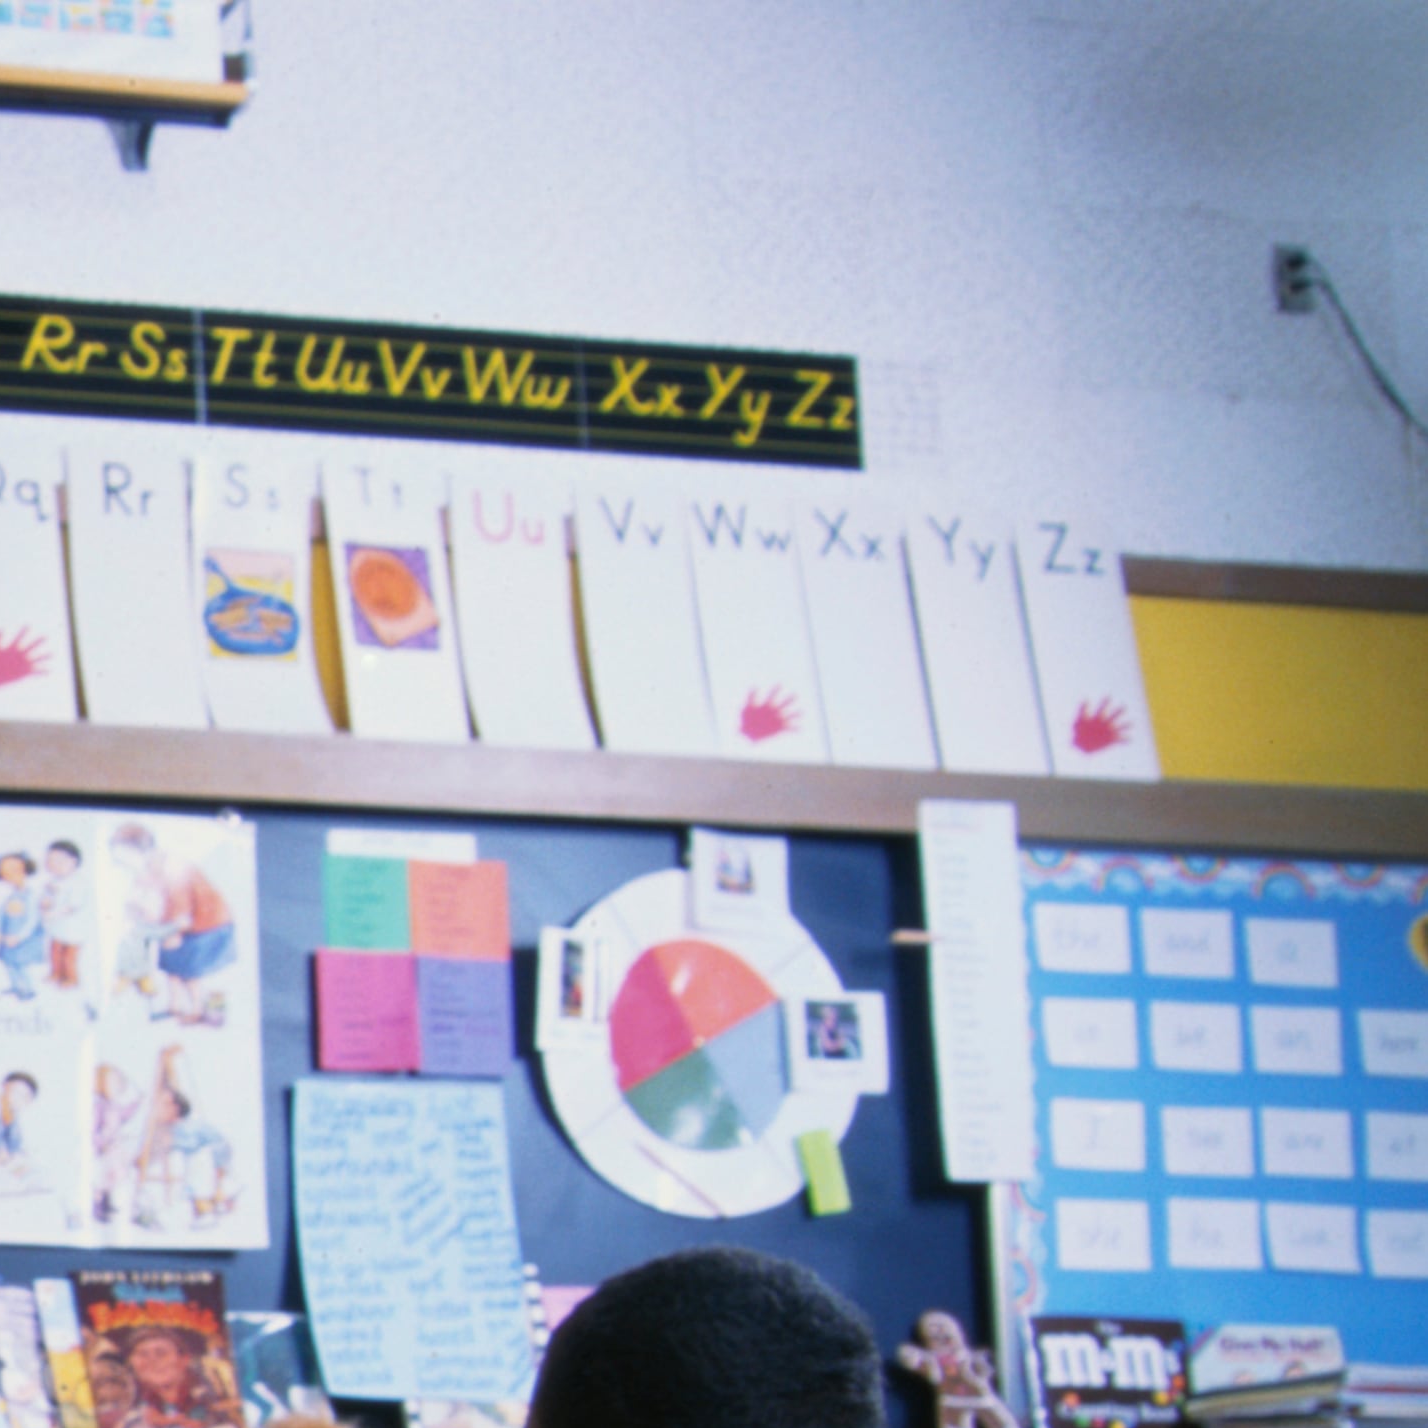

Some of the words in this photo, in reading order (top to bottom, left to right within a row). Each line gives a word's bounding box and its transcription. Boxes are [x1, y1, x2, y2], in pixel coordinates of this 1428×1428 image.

[20, 314, 108, 374] Rr
[120, 321, 188, 381] Ss
[211, 326, 277, 388] Tt
[295, 334, 372, 397] Uu
[379, 340, 452, 400] Vv
[463, 347, 571, 409] Ww
[600, 357, 684, 417] Xx
[701, 365, 772, 446] Yy
[787, 370, 854, 429] Zz
[104, 461, 155, 518] Rr
[470, 491, 546, 547] Uu
[598, 497, 664, 548] Vv
[693, 502, 792, 554] Ww
[815, 507, 886, 564] Xx
[926, 513, 997, 583] Yy
[1039, 521, 1107, 577] Zz
